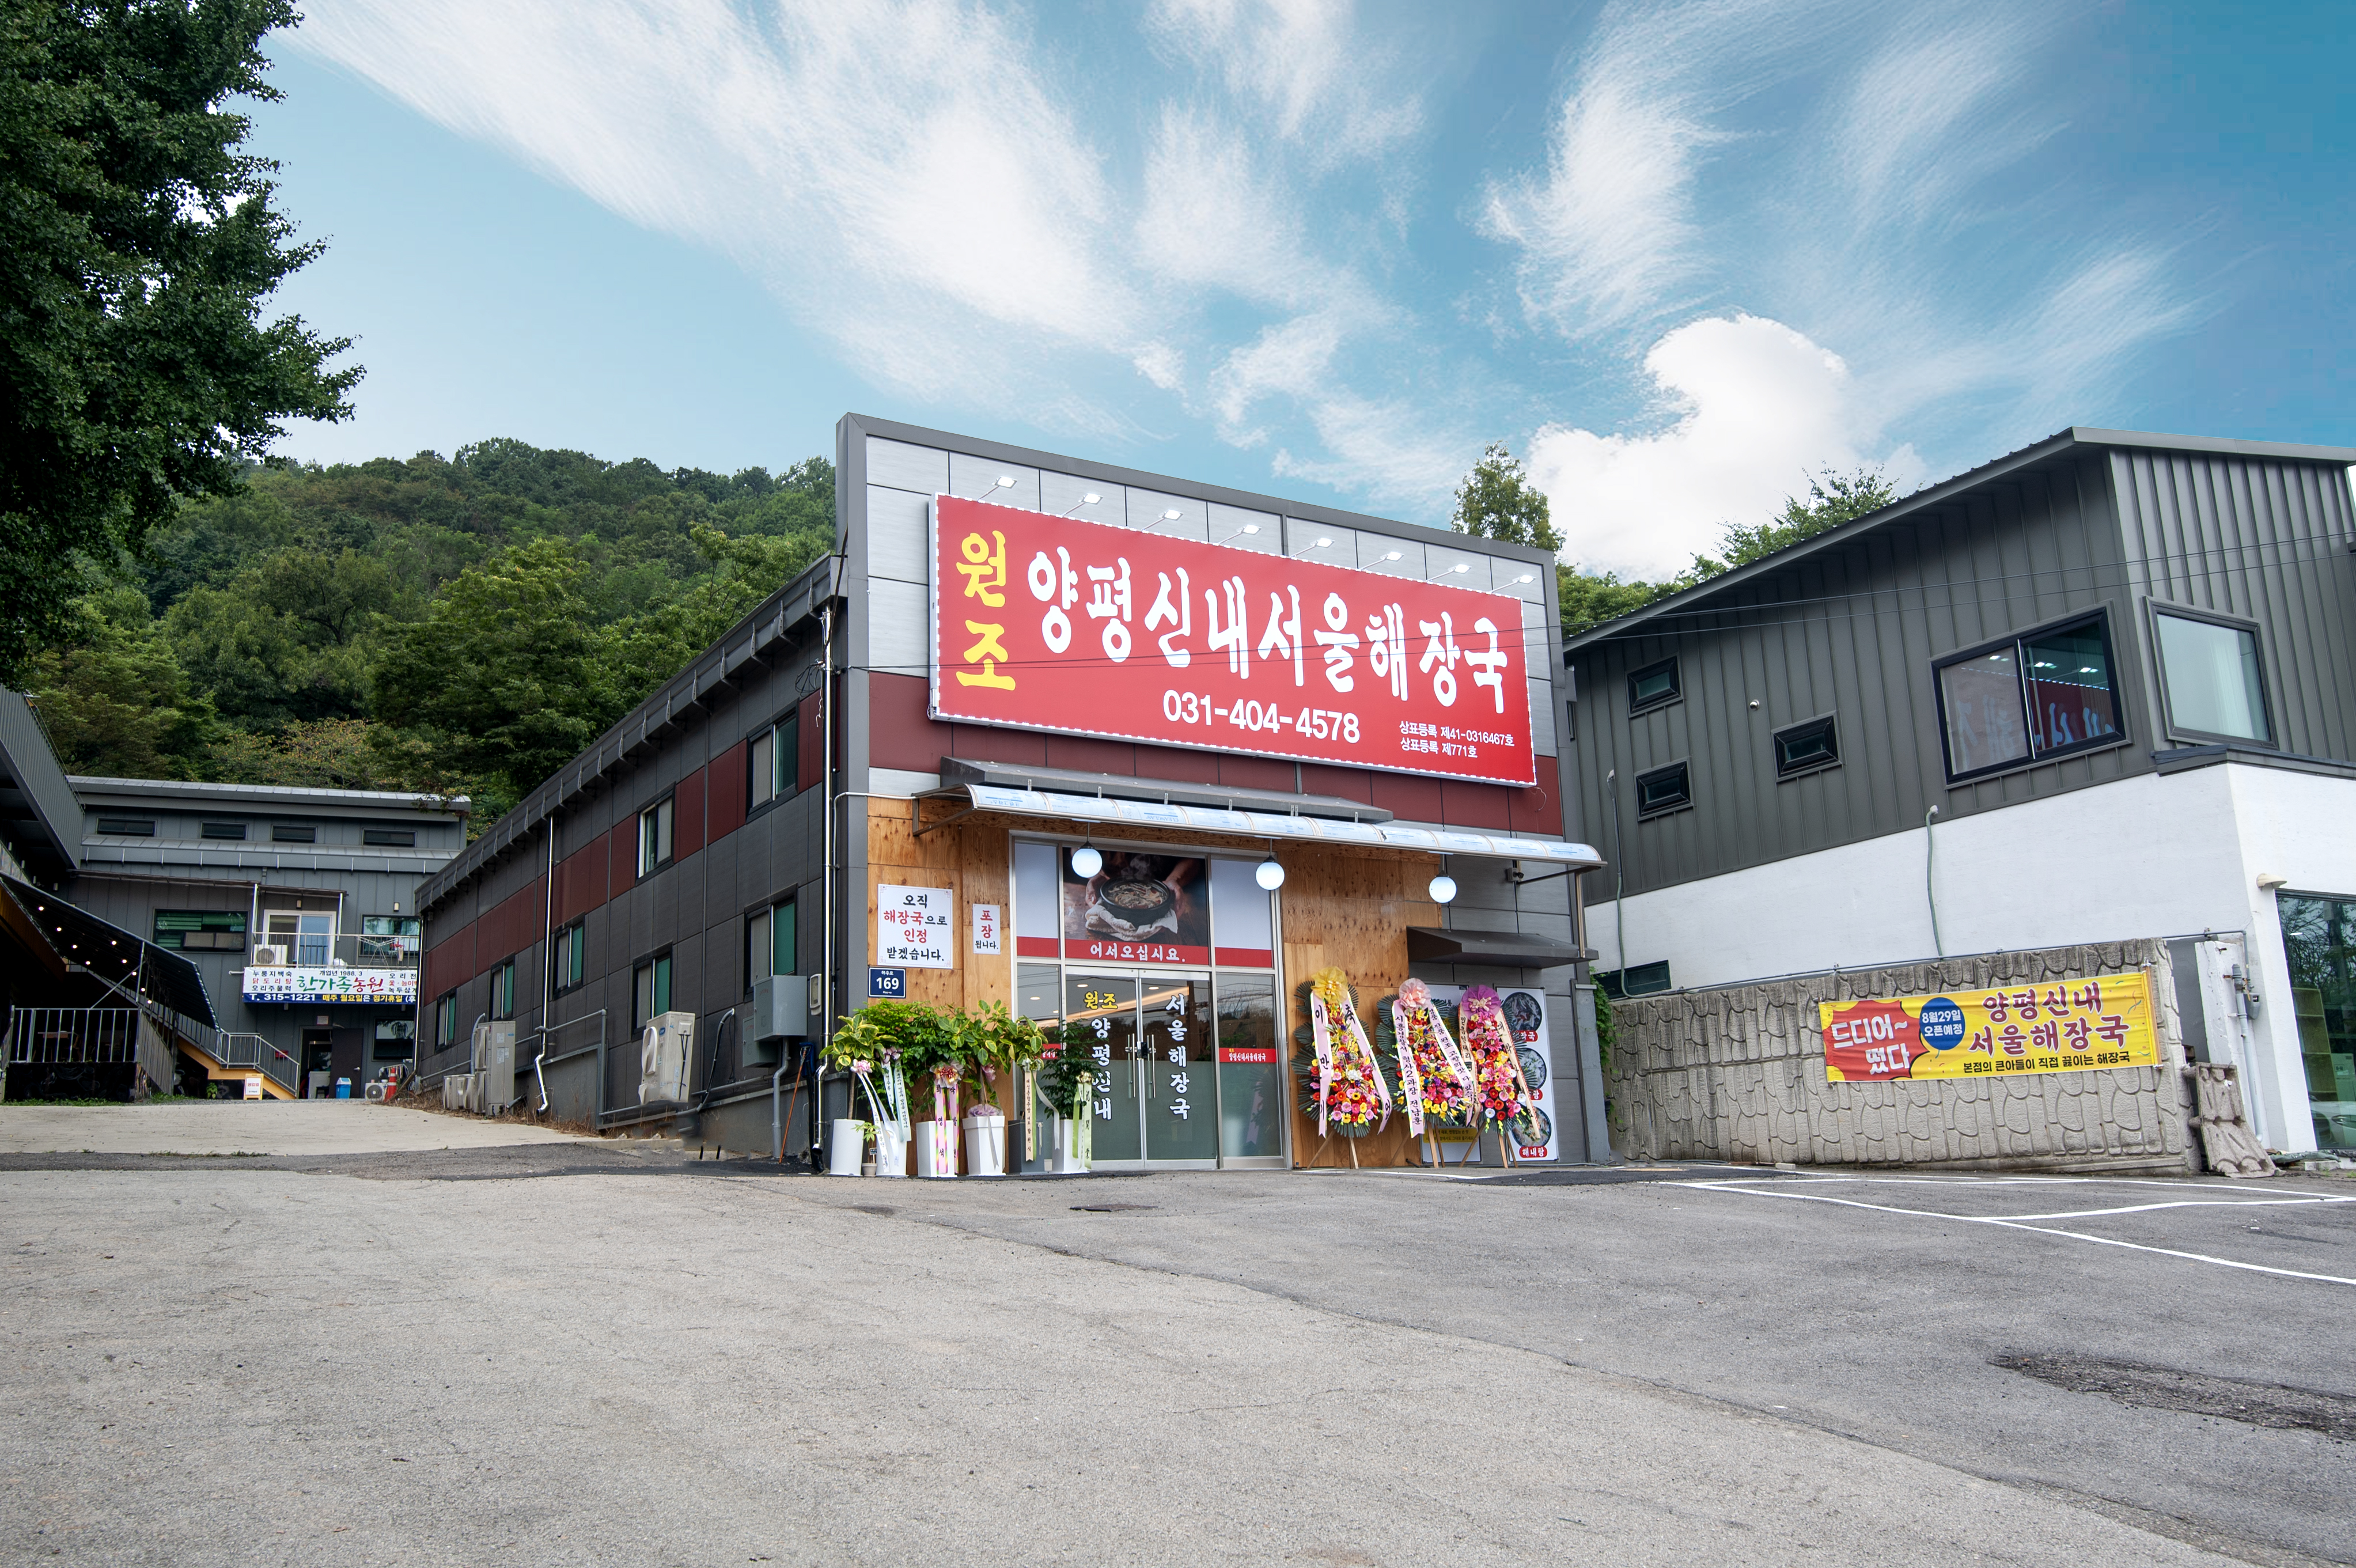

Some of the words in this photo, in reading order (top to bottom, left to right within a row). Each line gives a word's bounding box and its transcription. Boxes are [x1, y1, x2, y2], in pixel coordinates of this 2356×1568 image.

[956, 530, 1016, 691] 원조
[1028, 546, 1507, 714] 양평신내서울해장국
[1163, 690, 1360, 744] 031-404-4578
[1399, 721, 1438, 738] 상표등록
[1441, 726, 1515, 747] 제41-0316467호
[1400, 737, 1438, 754] 상표등록
[1442, 743, 1478, 758] 제771호
[903, 894, 928, 908] 오직
[884, 910, 948, 926] 해장국으로
[980, 910, 993, 938] 포장
[904, 928, 927, 944] 인정
[975, 940, 999, 949] 됩니다.
[887, 946, 945, 961] 받겠습니다.
[1090, 942, 1185, 962] 어서오십시요.
[297, 976, 384, 993] 한가족농원
[876, 977, 899, 990] 169
[1084, 991, 1118, 1009] 원조
[1982, 981, 2104, 1024] 양평신내
[1922, 1010, 1961, 1024] 8월29일
[1924, 1023, 1963, 1038] 오픈예정
[1968, 1015, 2130, 1058] 서울해장국
[1165, 994, 1191, 1120] 서울해장국
[1865, 1043, 1911, 1075] 떴다
[1963, 1061, 1992, 1074] 본점의
[1995, 1058, 2036, 1072] 큰아들이
[2038, 1056, 2059, 1070] 직접
[2063, 1054, 2094, 1068] 끓이는
[2097, 1051, 2131, 1065] 해장국
[1091, 1017, 1112, 1120] 양평신내
